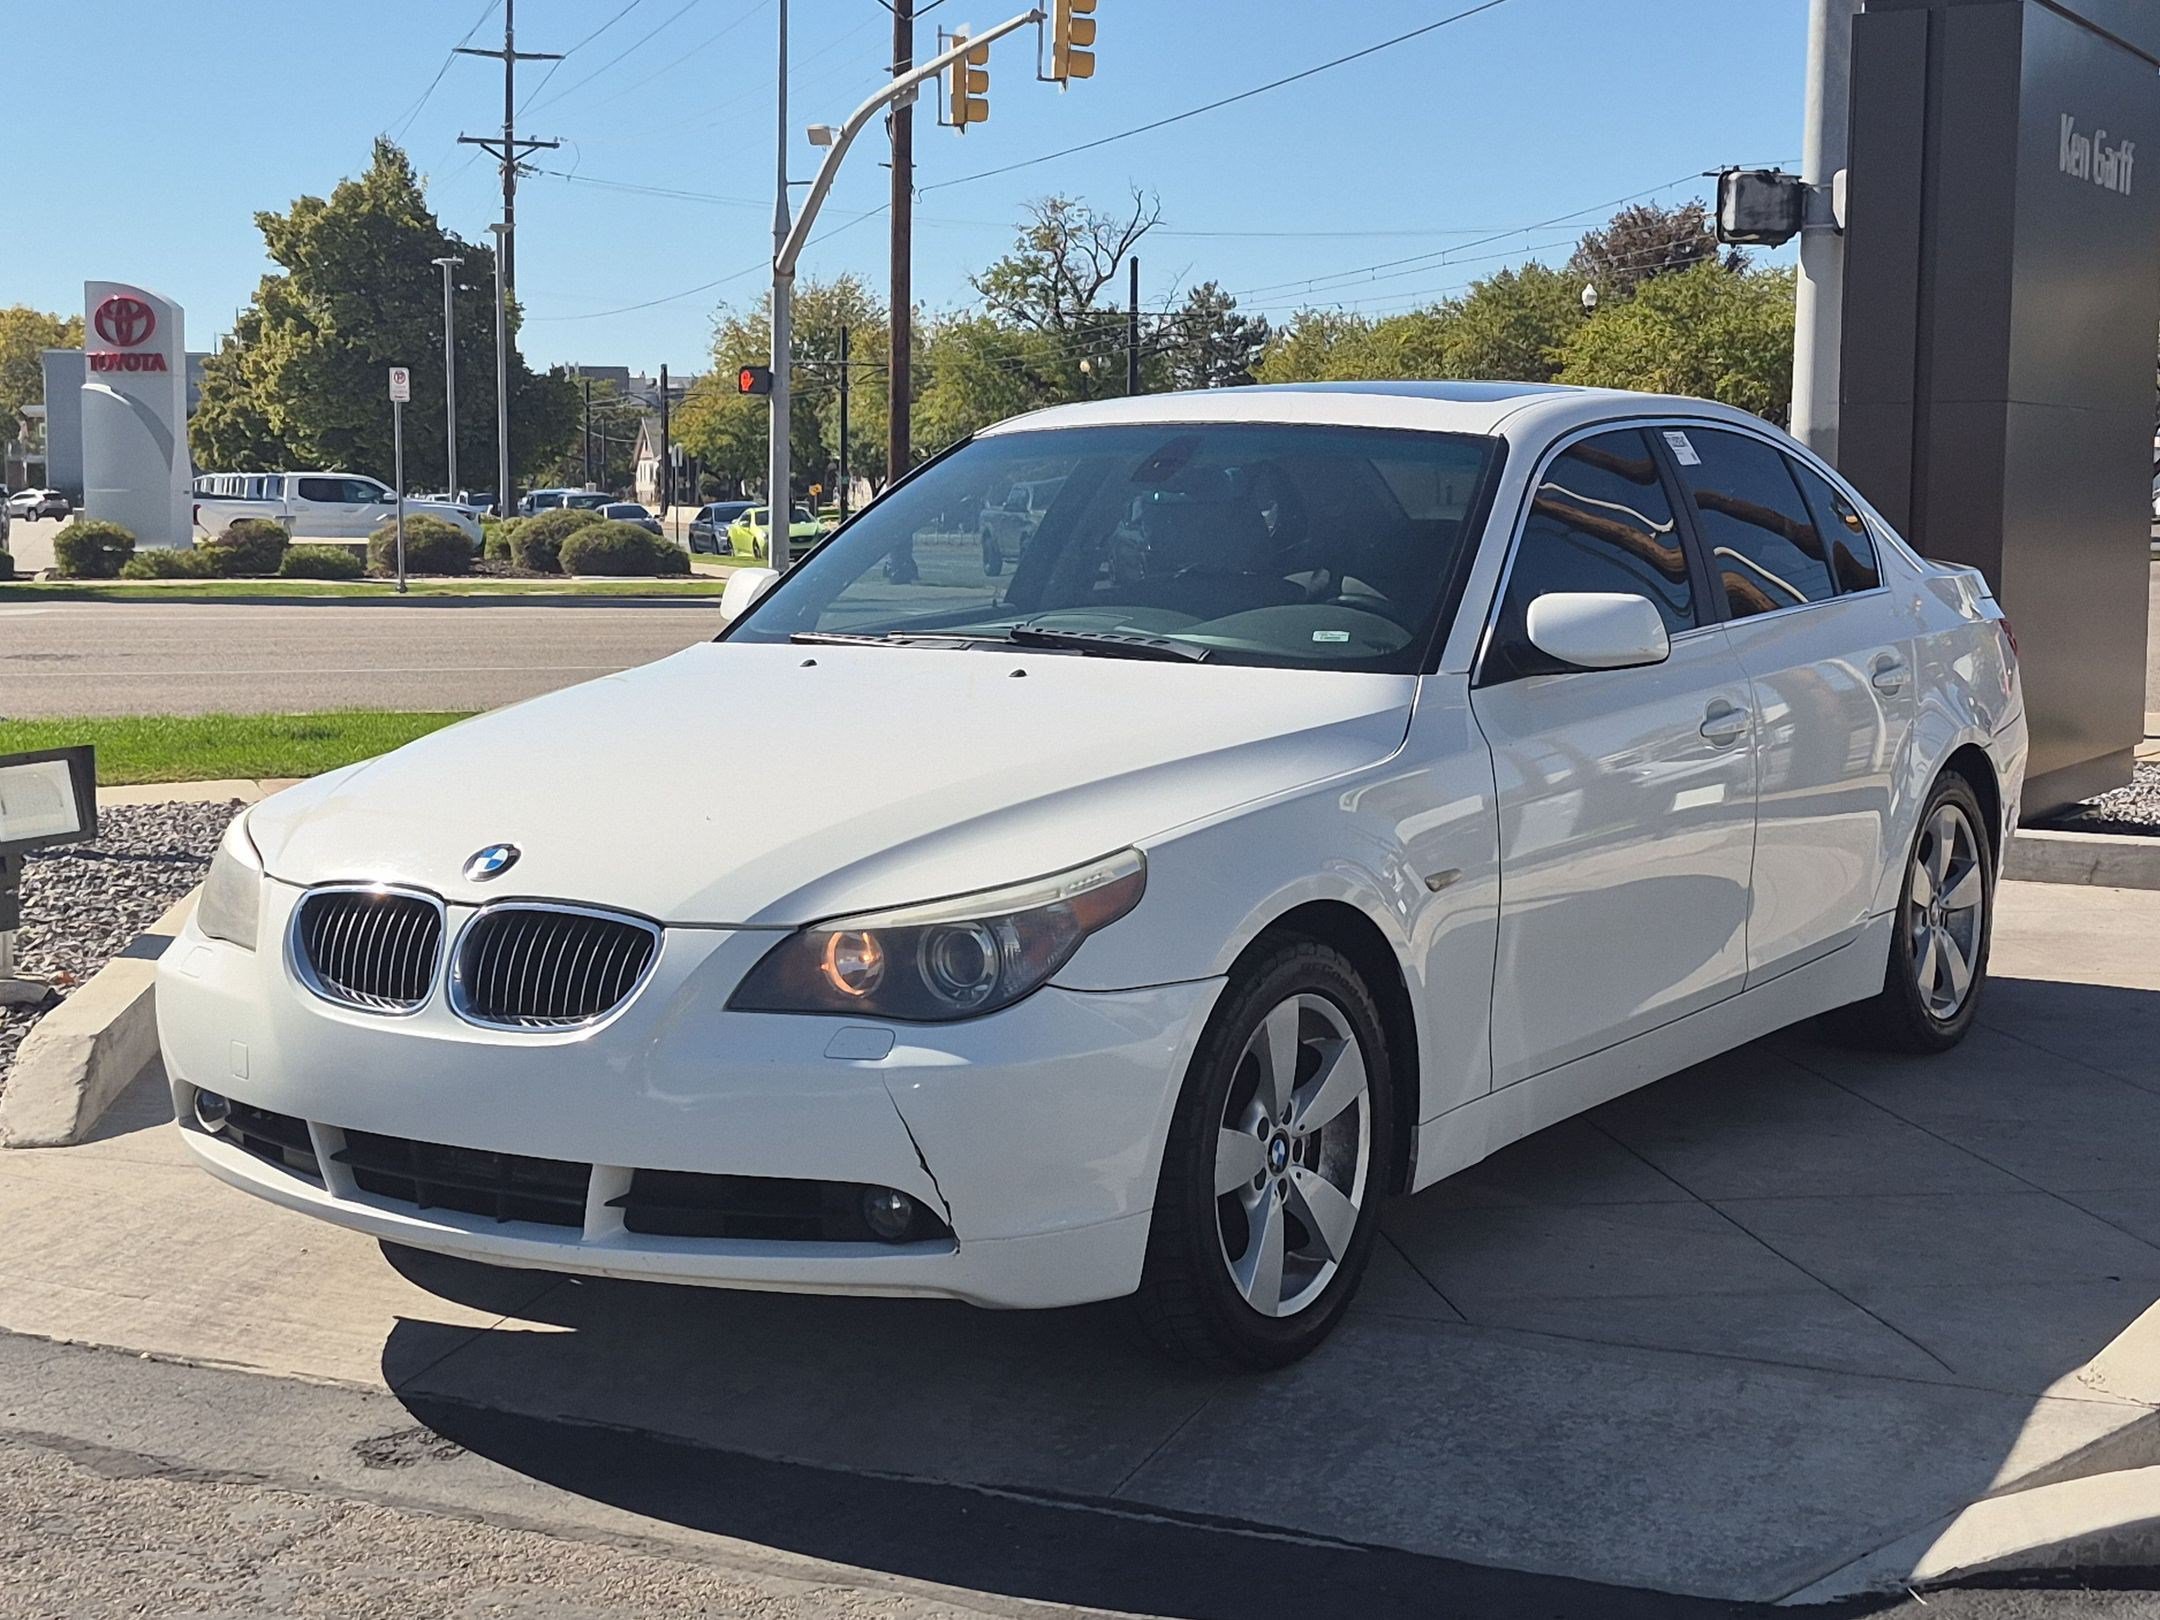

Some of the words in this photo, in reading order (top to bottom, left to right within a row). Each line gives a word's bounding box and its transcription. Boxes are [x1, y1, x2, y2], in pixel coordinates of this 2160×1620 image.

[2060, 113, 2090, 181] Ken
[2093, 129, 2135, 195] Garff
[86, 352, 168, 372] TOYOTA
